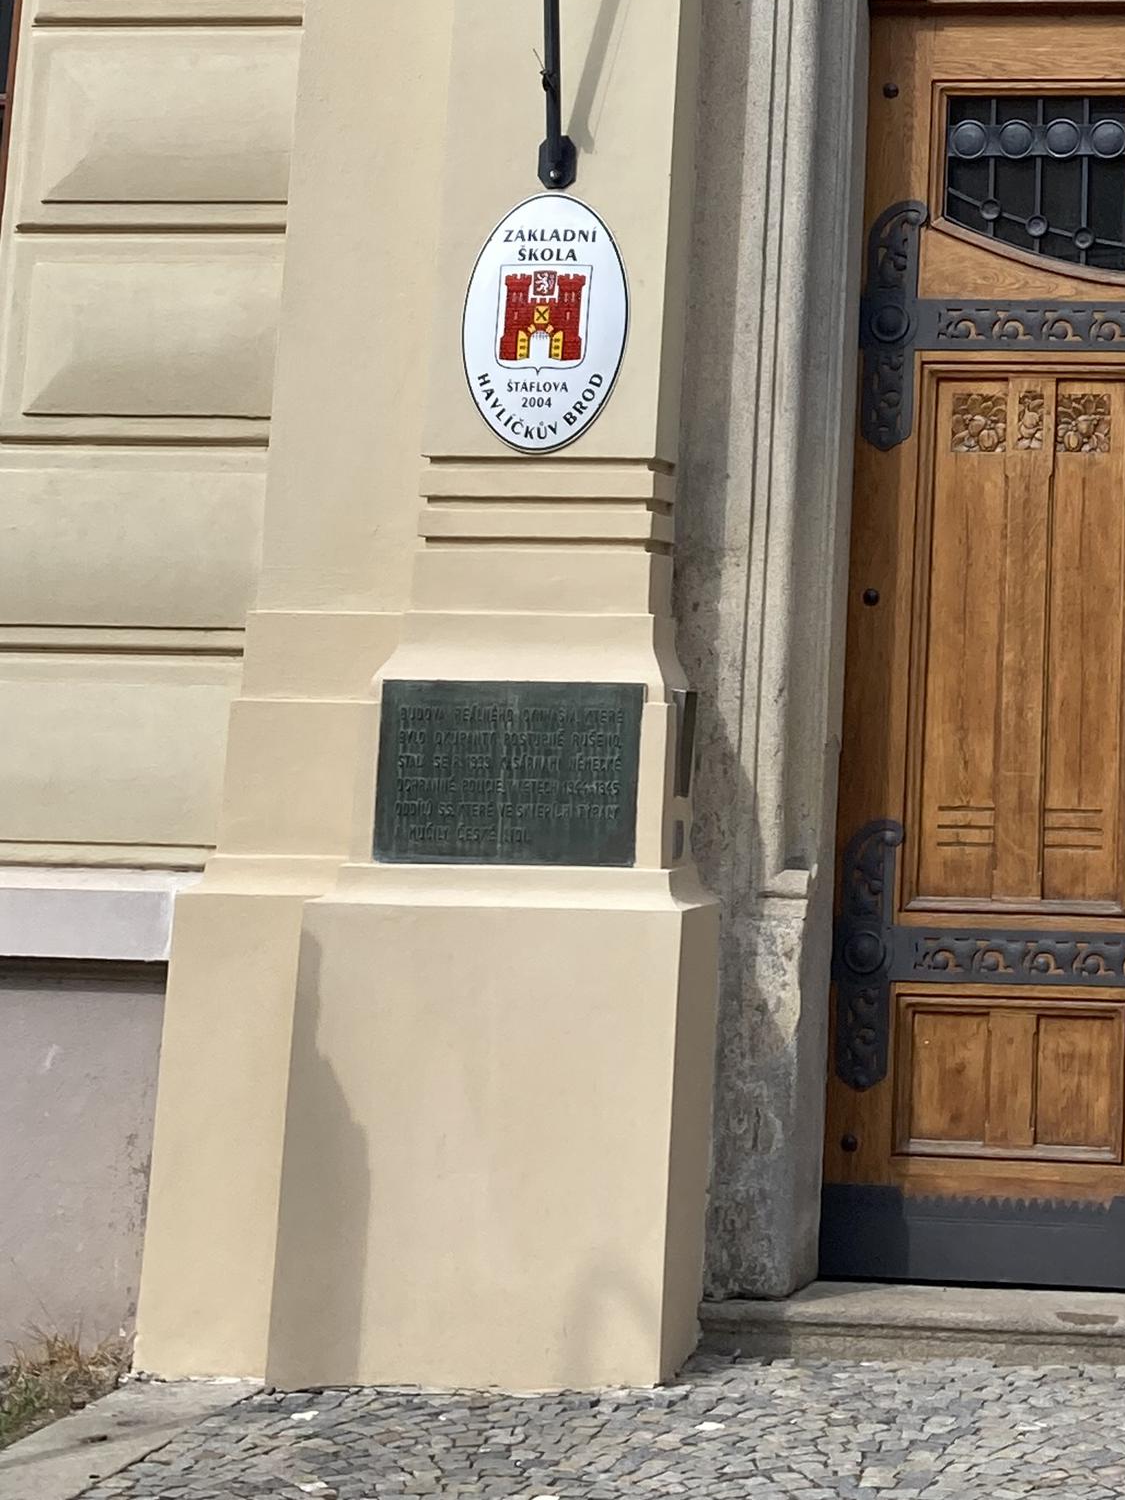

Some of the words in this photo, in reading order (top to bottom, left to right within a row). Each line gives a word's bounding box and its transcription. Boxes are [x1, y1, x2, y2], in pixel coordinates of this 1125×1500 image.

[504, 226, 597, 242] ZÁKLADNÍ
[517, 245, 578, 261] ŠKOLA
[507, 379, 569, 393] ŠTÁFLOVA
[477, 373, 558, 440] HAVLÍČKŮV
[563, 373, 603, 426] BROD
[521, 397, 552, 408] 2004
